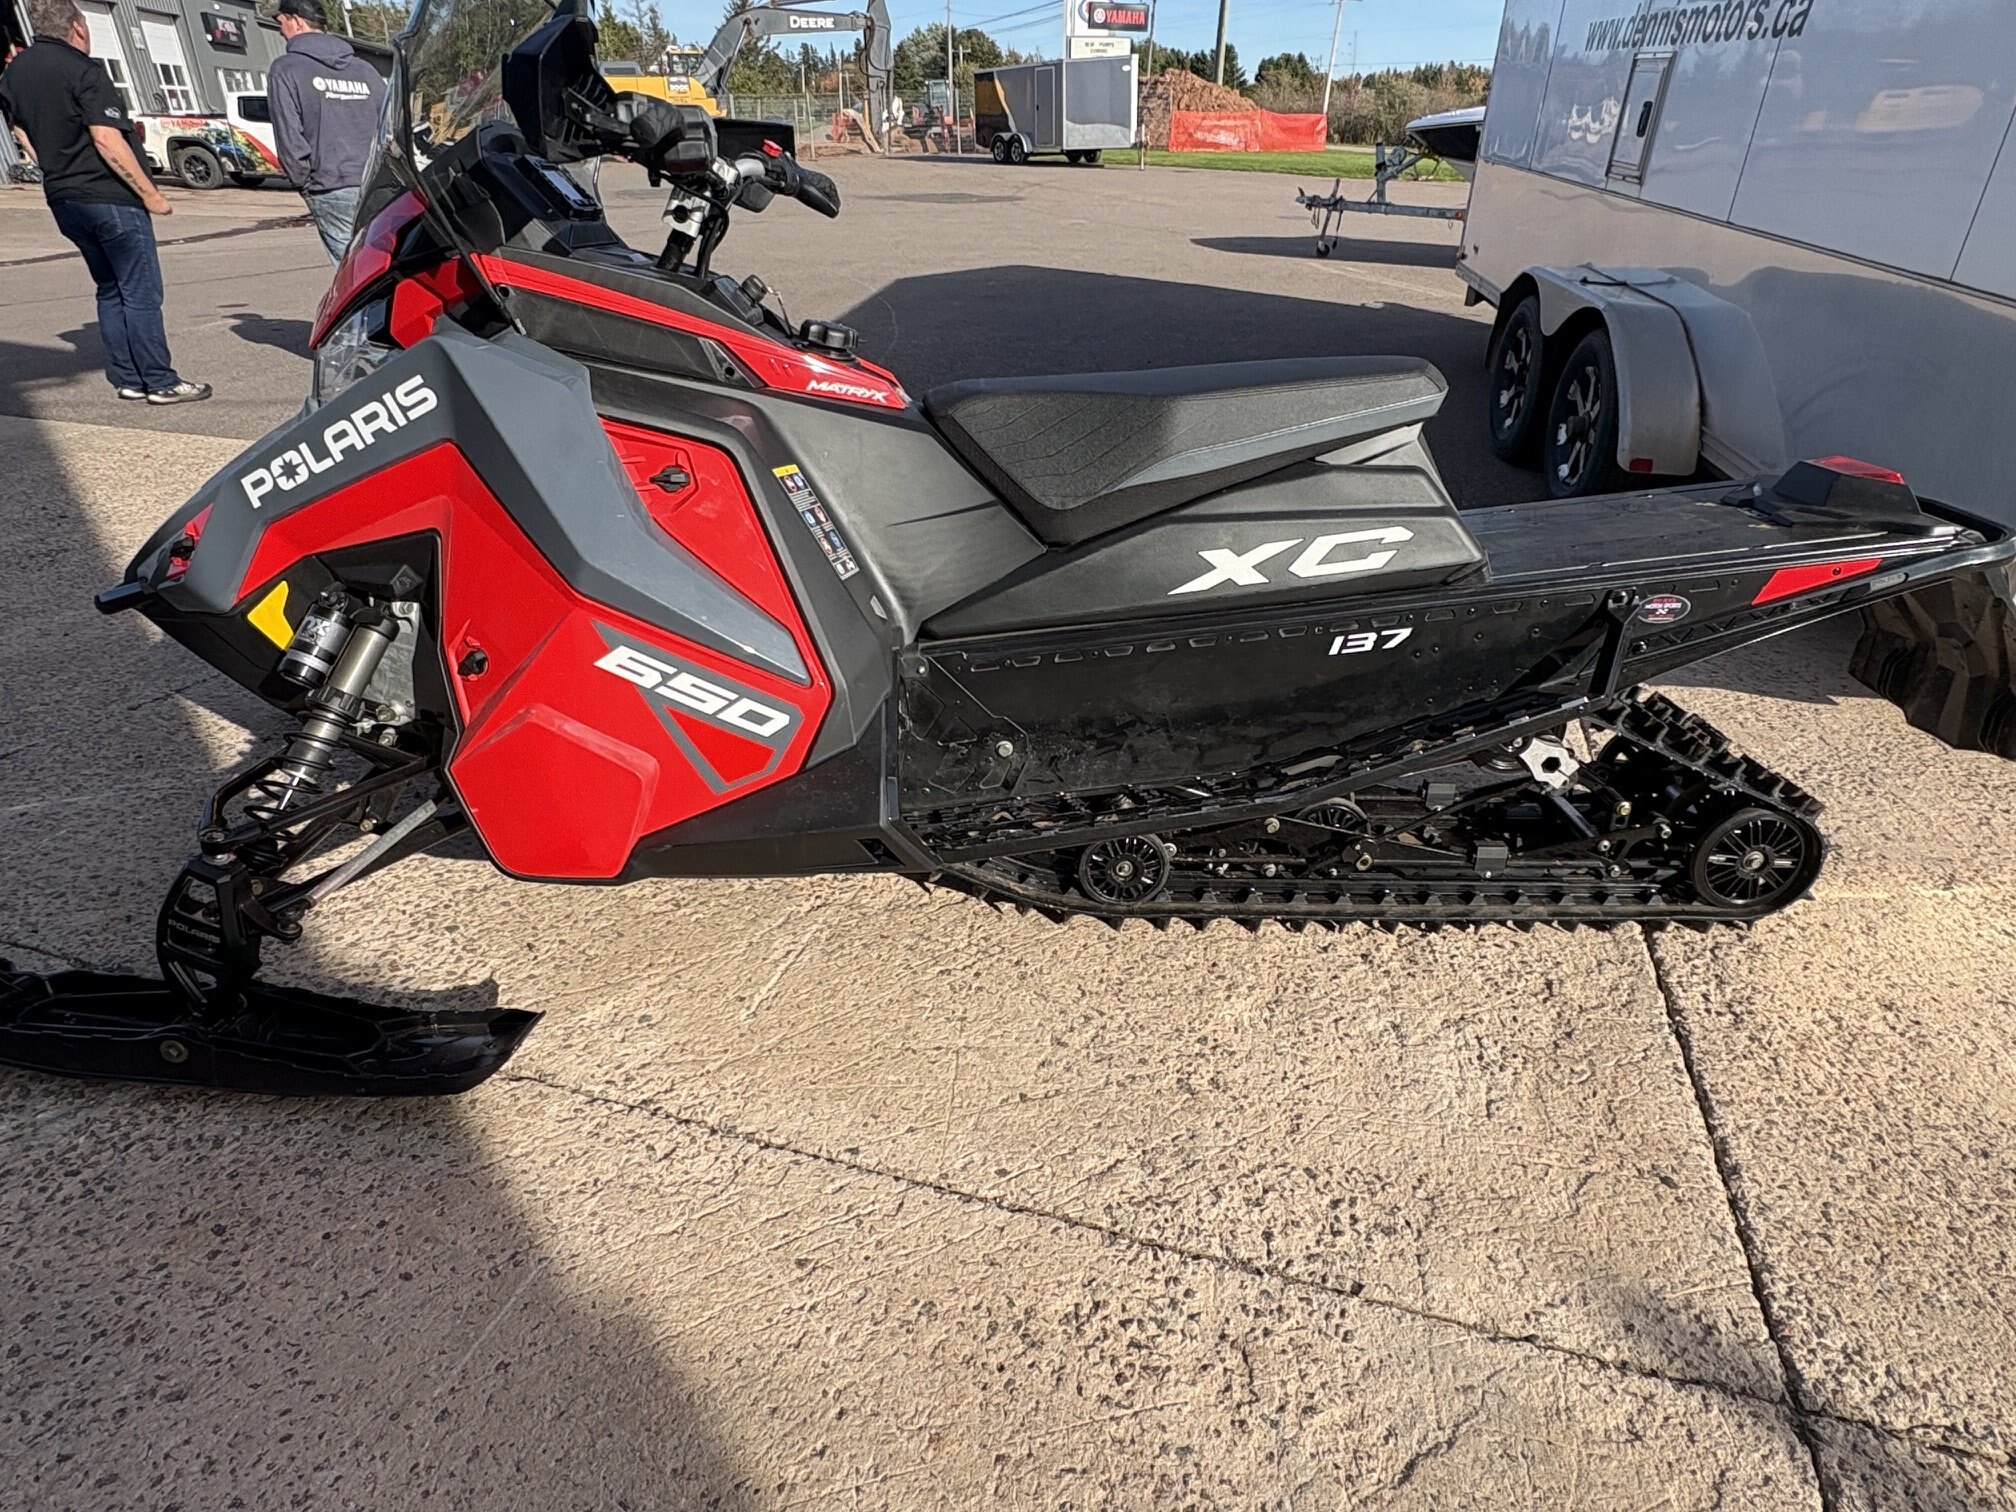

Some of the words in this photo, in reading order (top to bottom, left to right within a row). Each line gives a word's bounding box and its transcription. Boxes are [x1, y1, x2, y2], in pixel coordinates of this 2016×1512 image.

[790, 15, 835, 28] DEERE
[1106, 10, 1145, 25] YAMAHA
[1585, 0, 1814, 51] www.dennismotors.ca
[325, 78, 371, 94] YAMAHA
[806, 380, 890, 404] MATRYX
[240, 375, 438, 509] POLARIS
[1167, 526, 1415, 595] XC
[1328, 627, 1413, 656] 137
[593, 645, 790, 737] 650
